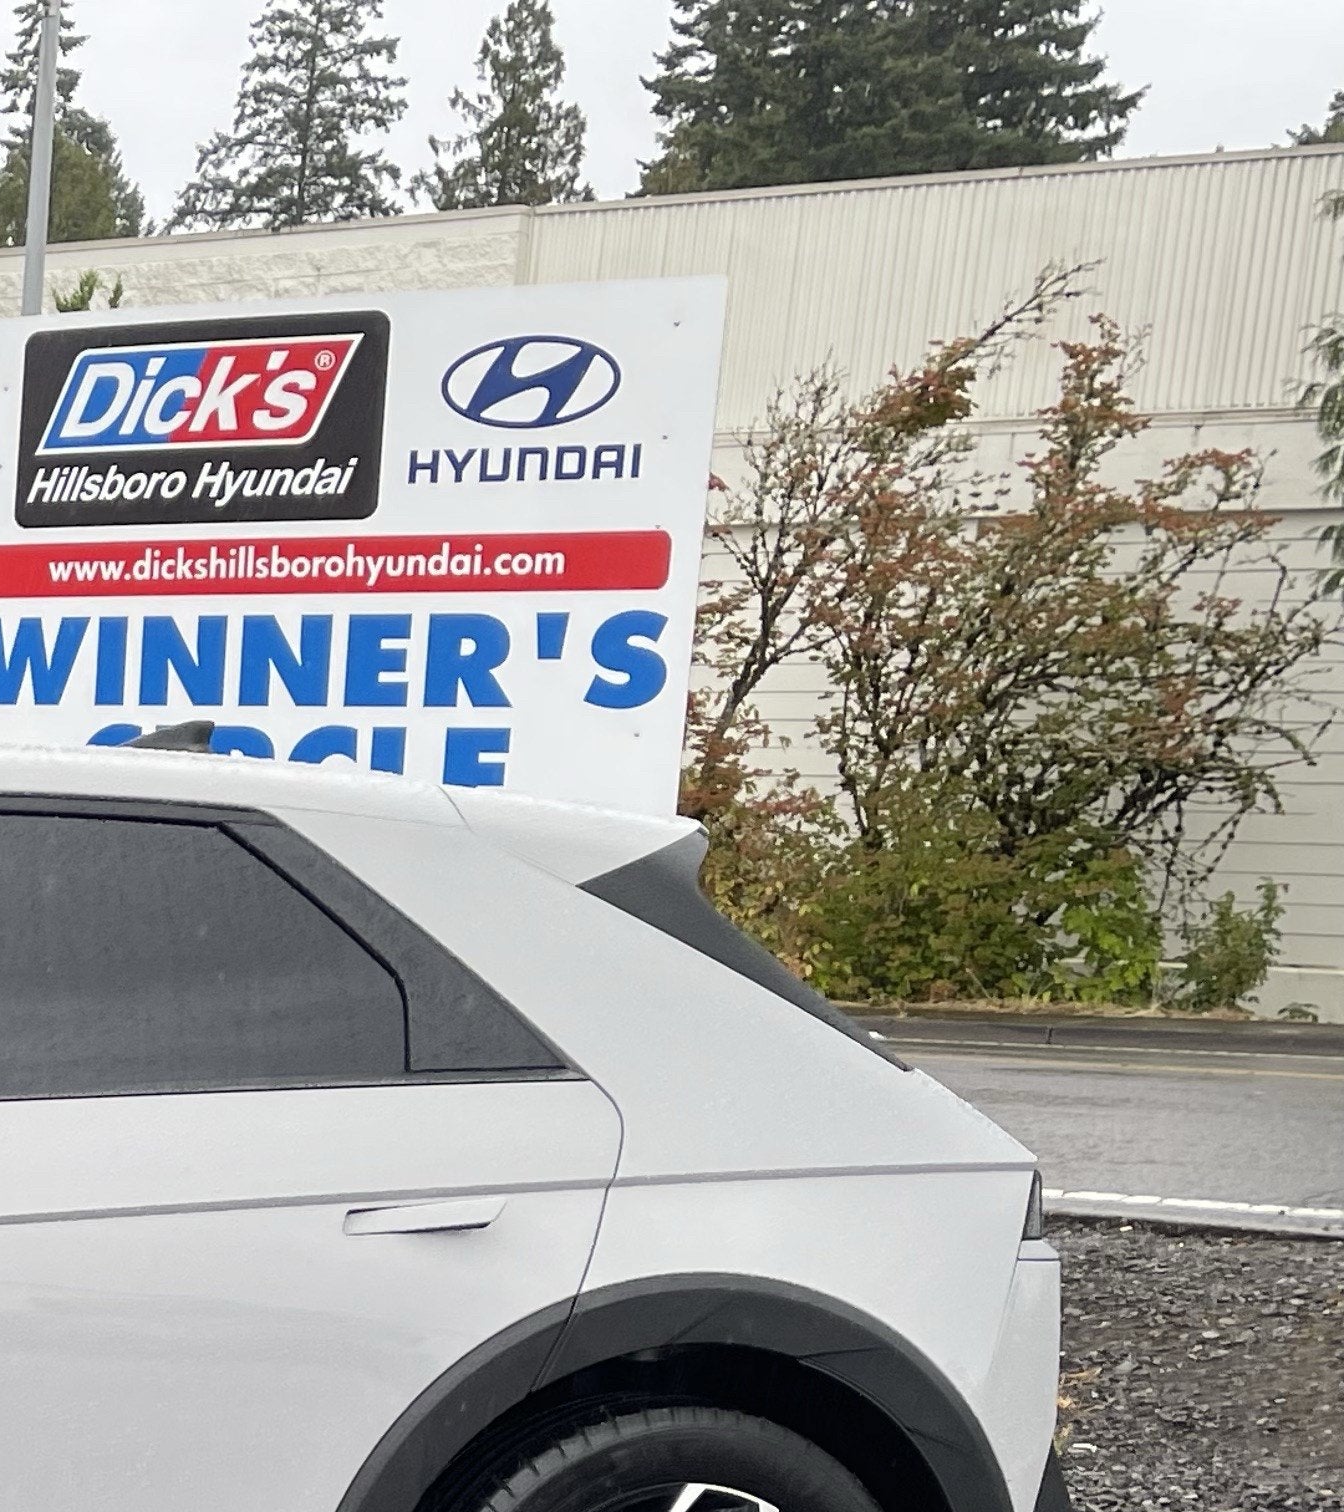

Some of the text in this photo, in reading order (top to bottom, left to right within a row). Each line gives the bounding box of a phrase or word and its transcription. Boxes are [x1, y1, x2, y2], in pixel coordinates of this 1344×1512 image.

[27, 457, 359, 507] Hillsboro Hyundai
[409, 443, 643, 484] HYUNDAI
[49, 545, 566, 586] www.dickshillsborohyundai.com
